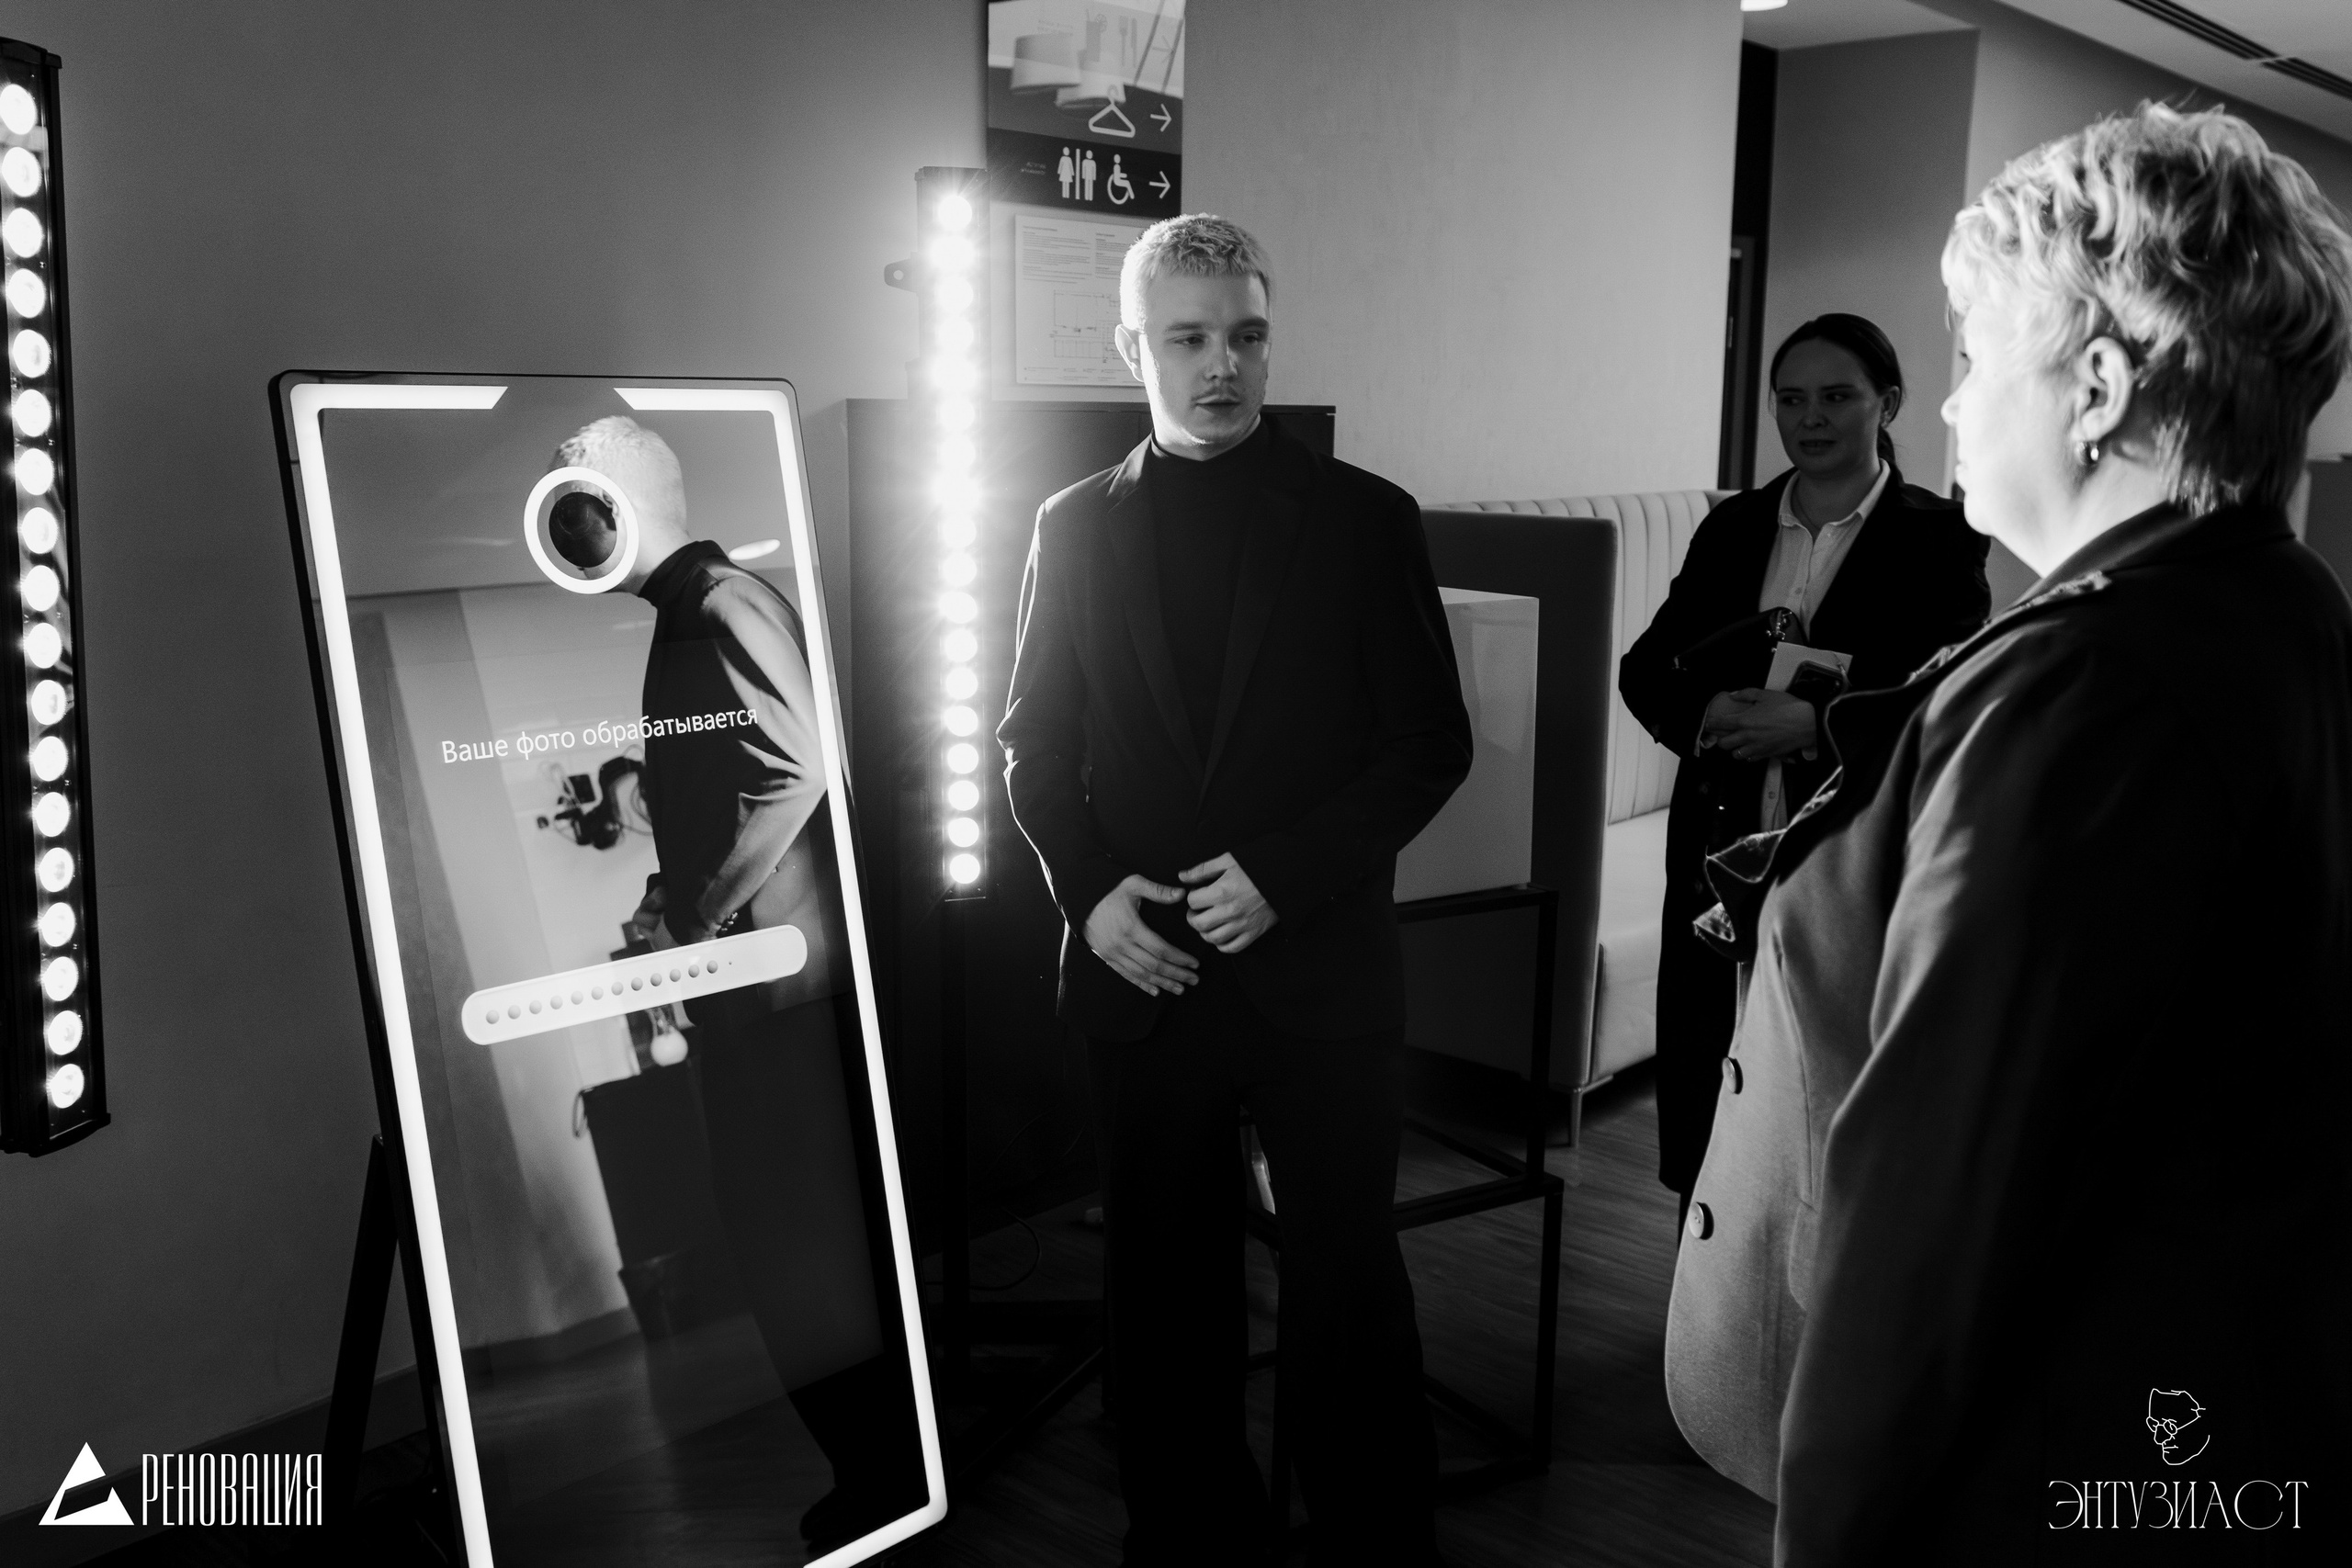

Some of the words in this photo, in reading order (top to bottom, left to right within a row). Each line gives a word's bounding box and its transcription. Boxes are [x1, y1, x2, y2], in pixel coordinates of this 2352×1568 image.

[441, 739, 509, 763] Ваше
[515, 731, 576, 761] фото
[582, 708, 759, 748] обрабатывается
